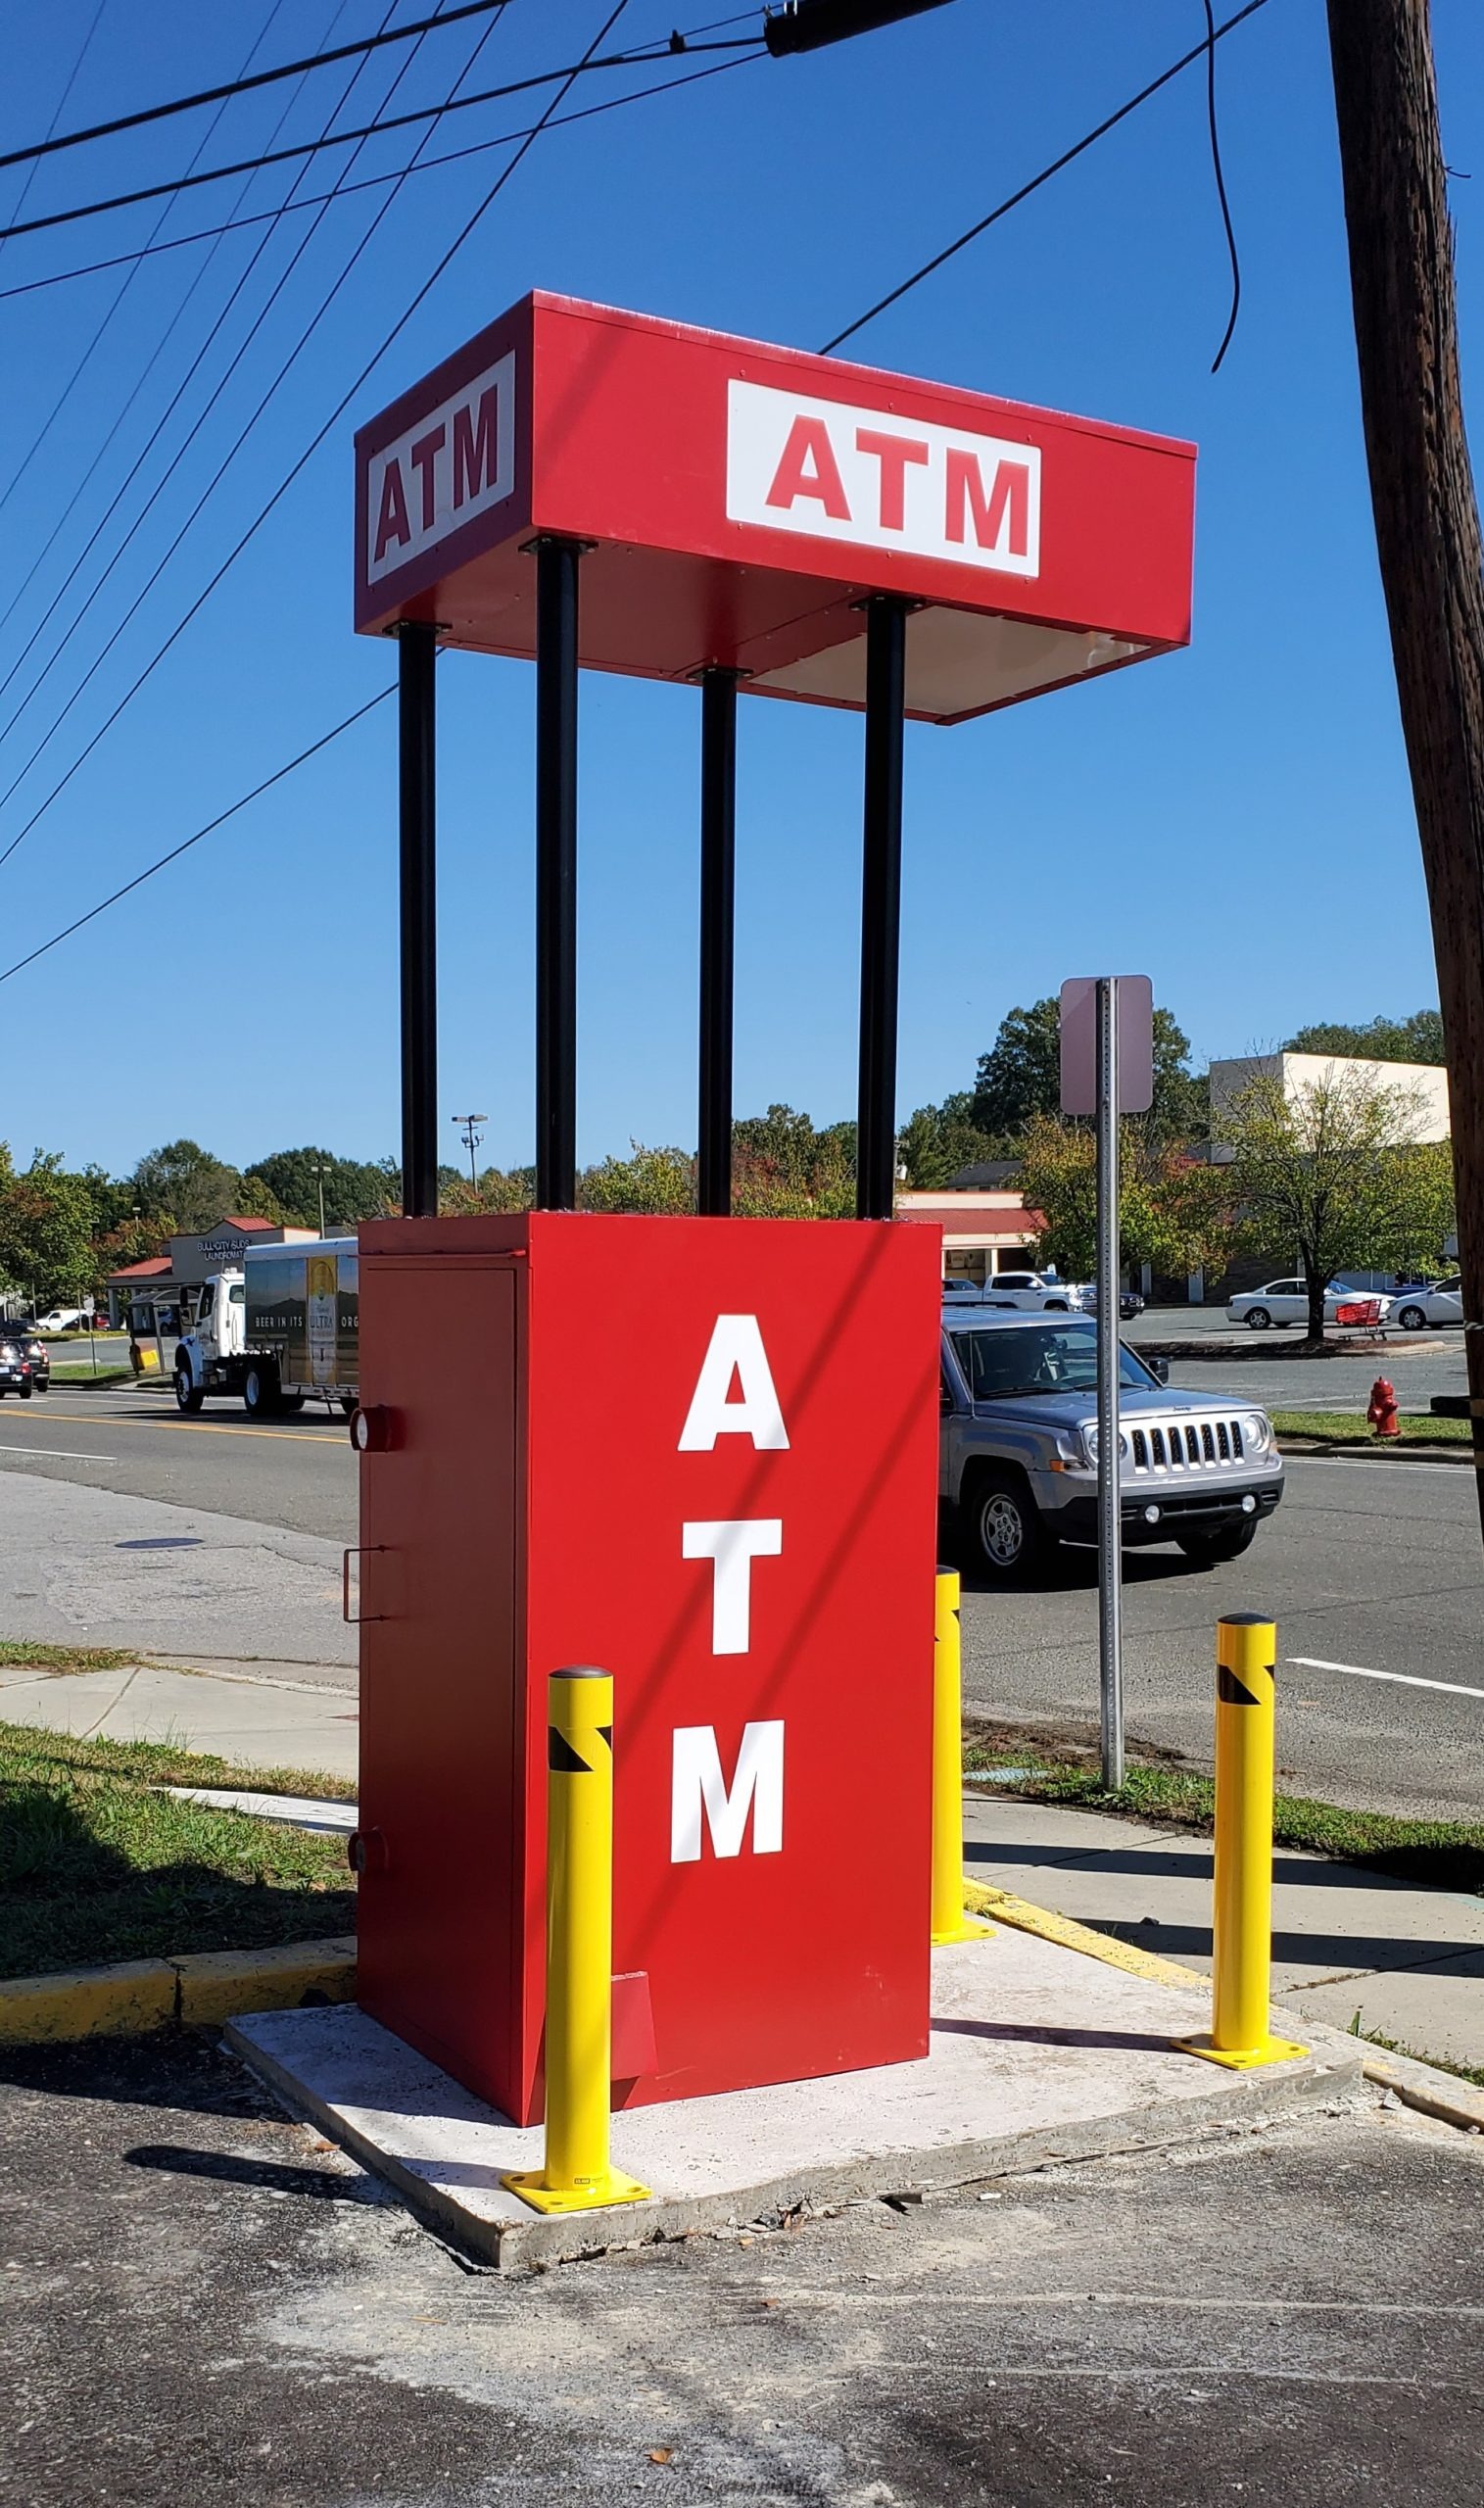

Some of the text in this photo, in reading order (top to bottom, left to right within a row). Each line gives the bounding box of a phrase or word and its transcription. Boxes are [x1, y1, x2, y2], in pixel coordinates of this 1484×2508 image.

[373, 383, 500, 563] ATM
[764, 413, 1029, 557] ATM
[256, 1317, 274, 1327] BEER
[277, 1317, 286, 1326] IN
[290, 1316, 303, 1326] ITS
[670, 1314, 790, 1863] ATM
